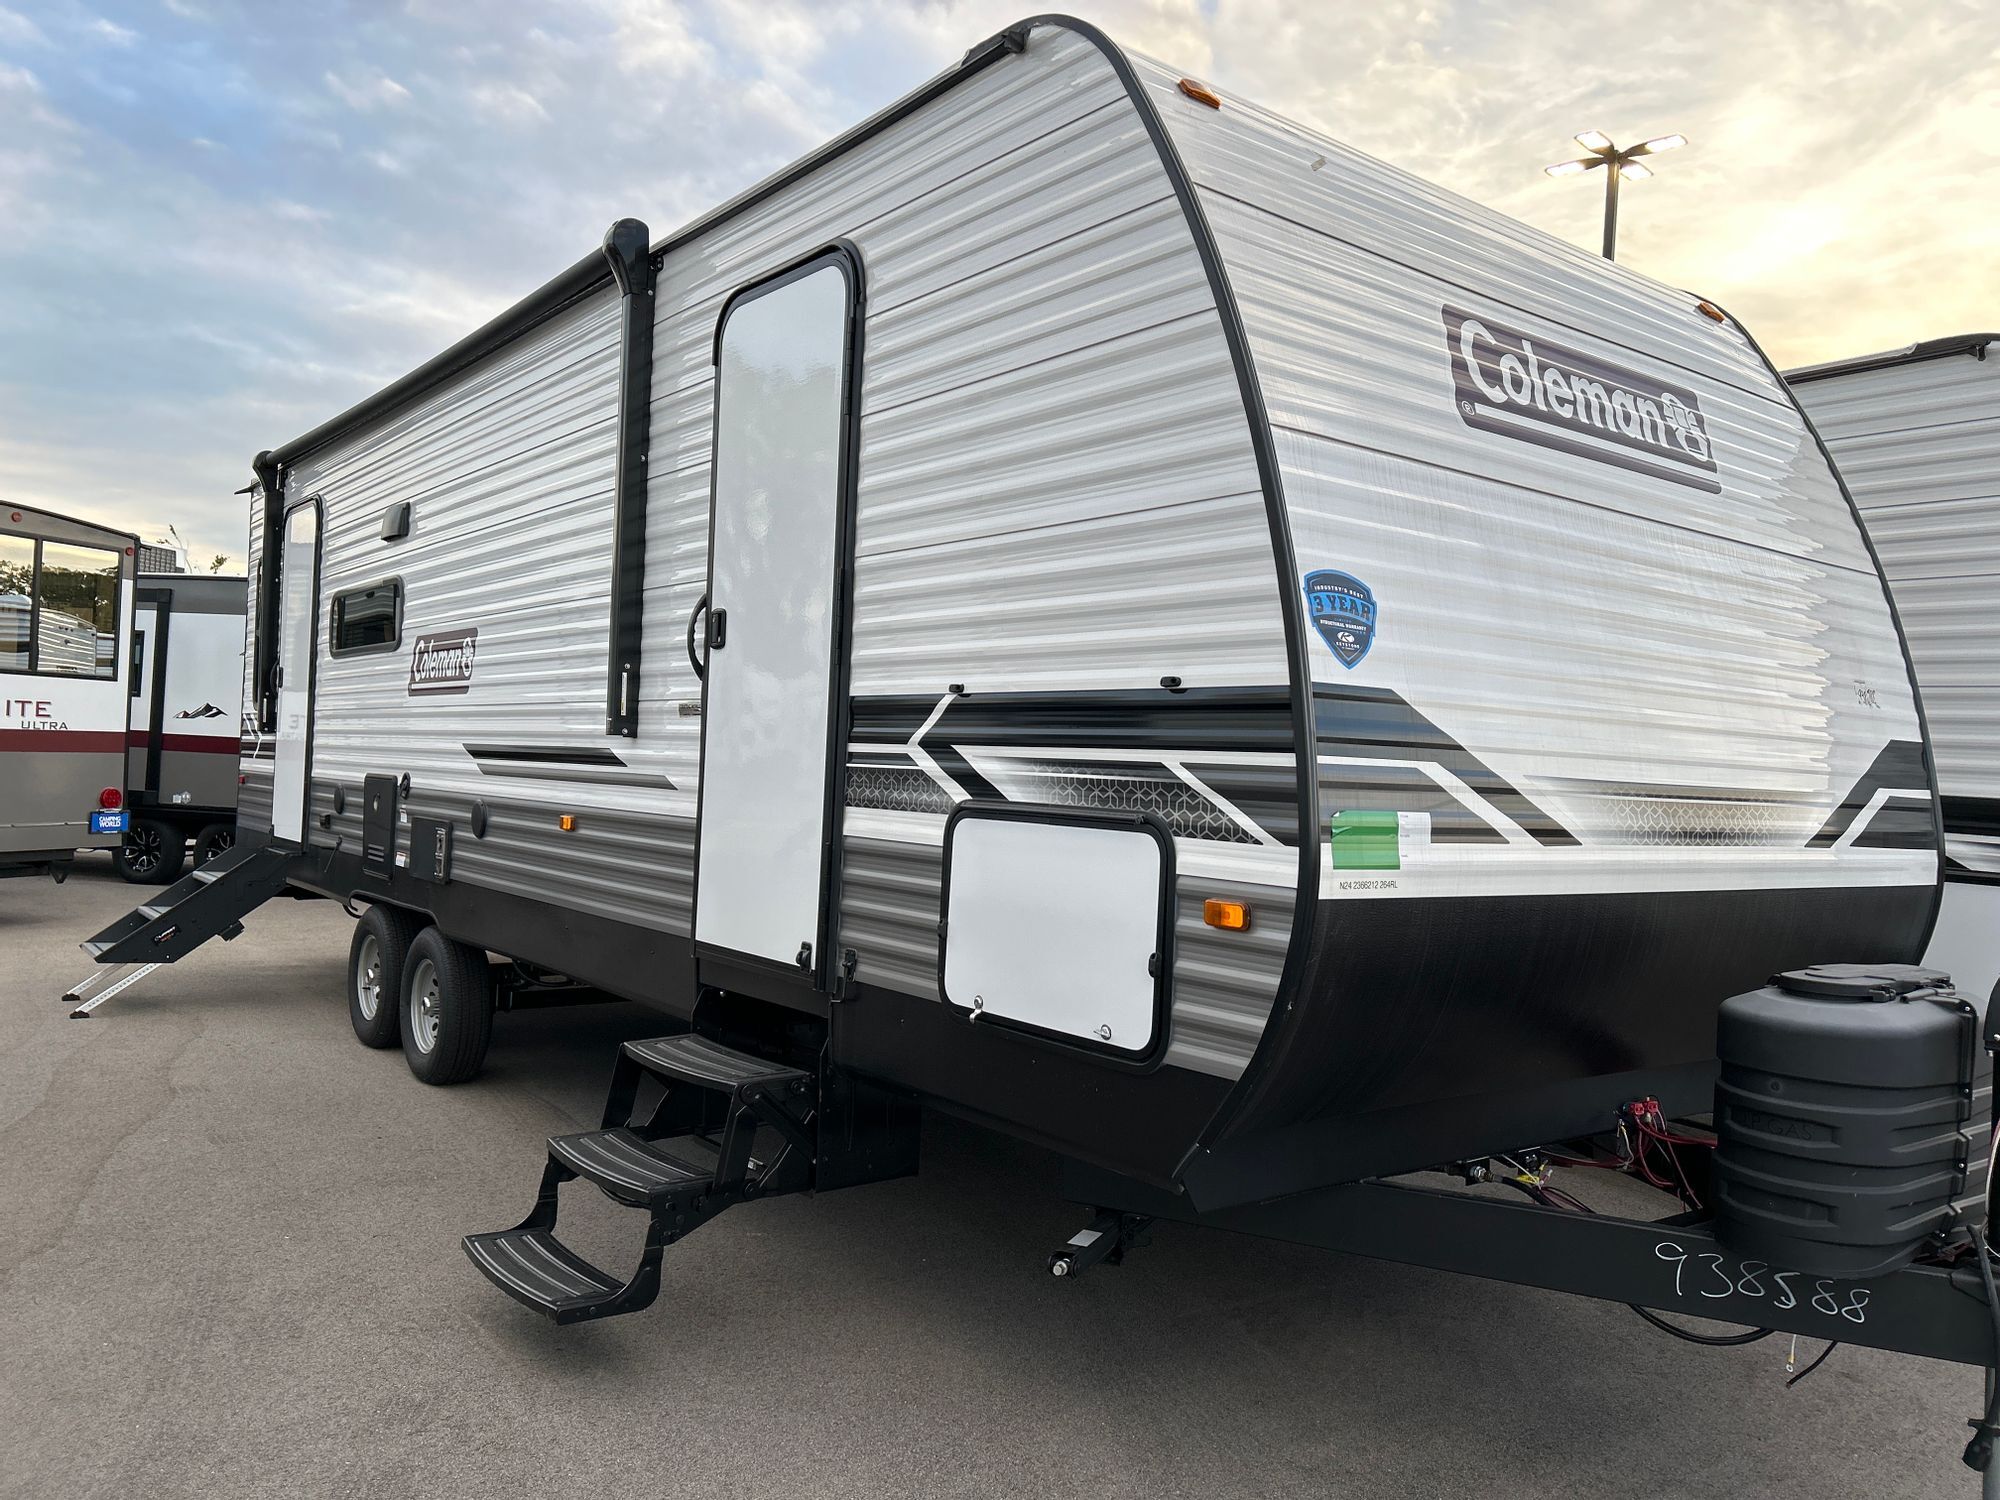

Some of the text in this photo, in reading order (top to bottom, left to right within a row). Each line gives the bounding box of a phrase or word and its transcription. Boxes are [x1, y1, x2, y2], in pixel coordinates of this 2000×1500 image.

[1459, 319, 1670, 449] Coleman
[1313, 595, 1371, 619] 3 YEAR
[413, 639, 462, 682] Coleman
[6, 699, 52, 718] ITE
[21, 720, 68, 730] ULTRA
[99, 820, 121, 828] WORLD
[1339, 881, 1352, 889] N24
[1380, 880, 1398, 889] 264RL
[1768, 1118, 1816, 1140] GAS
[1654, 1242, 1871, 1323] 938588
